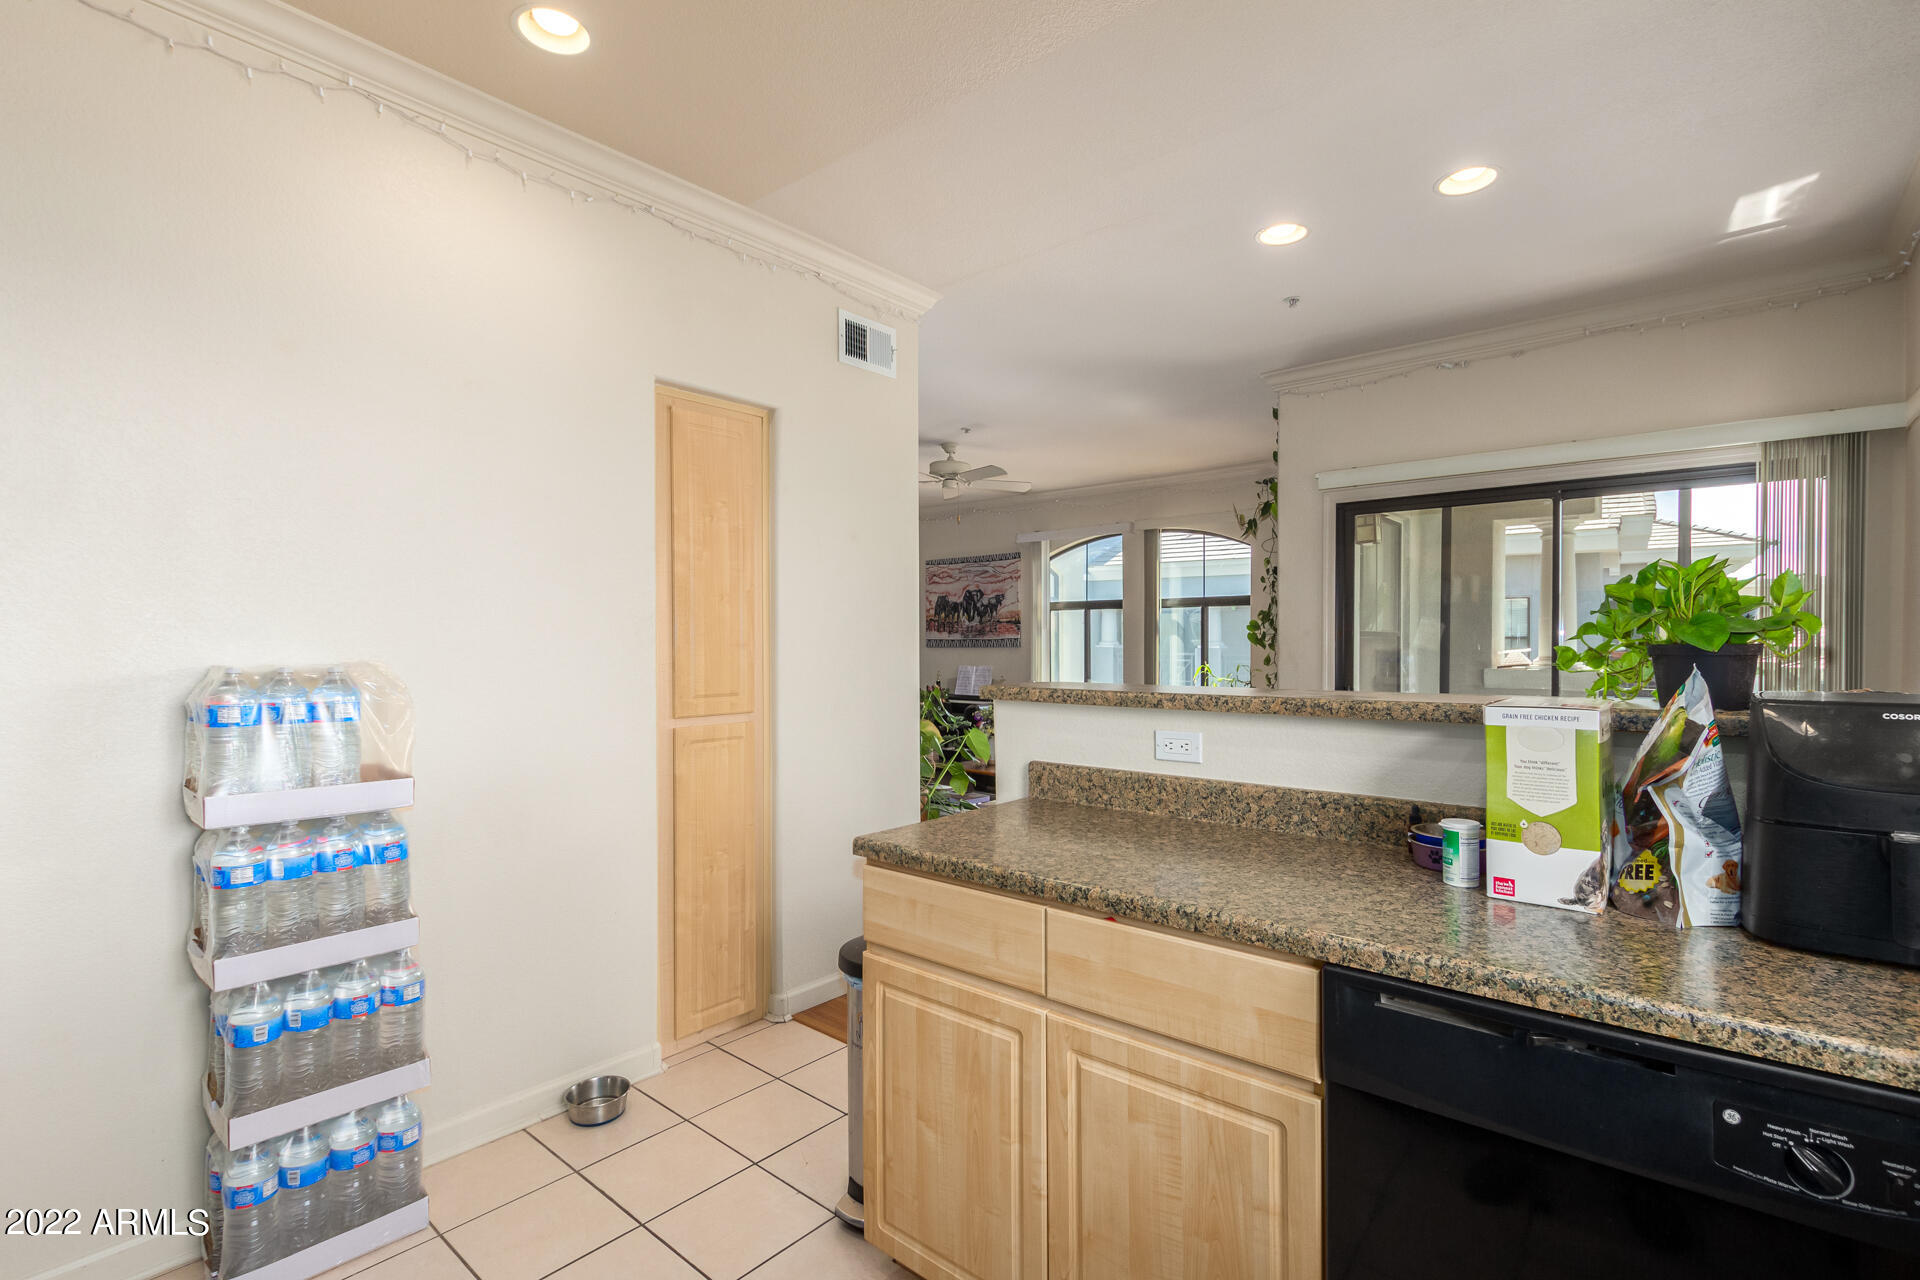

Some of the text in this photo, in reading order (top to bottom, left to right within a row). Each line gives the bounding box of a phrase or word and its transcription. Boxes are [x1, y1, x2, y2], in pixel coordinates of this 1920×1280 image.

[1882, 712, 1920, 721] COSOR
[1767, 1123, 1801, 1136] Heavy Wash
[1809, 1127, 1848, 1141] Normal Wash
[1773, 1133, 1788, 1142] Start
[1821, 1137, 1855, 1149] Light Wash
